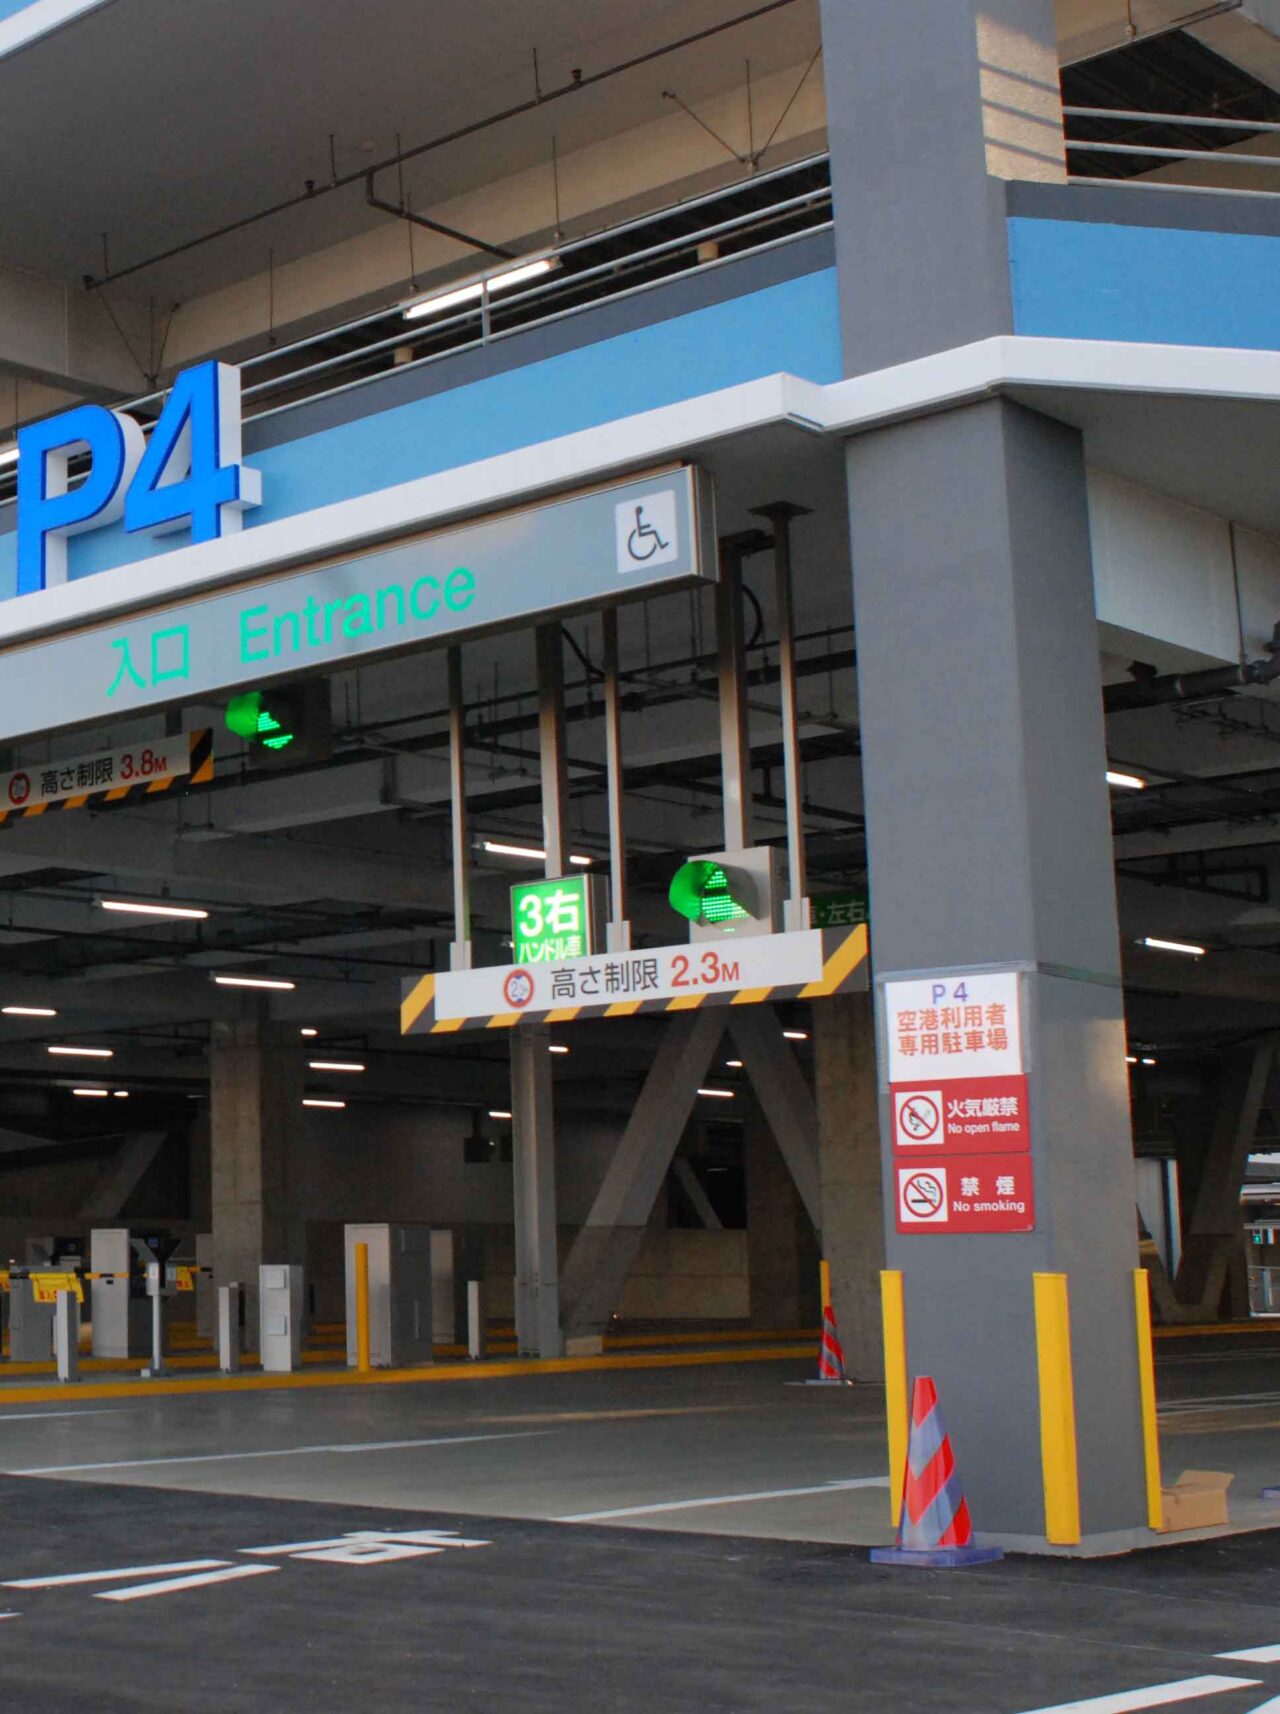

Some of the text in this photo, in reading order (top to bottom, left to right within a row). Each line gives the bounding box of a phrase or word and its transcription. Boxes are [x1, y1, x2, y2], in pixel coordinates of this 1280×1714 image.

[17, 360, 241, 597] P4
[107, 566, 476, 697] 入口 Entrance
[41, 757, 113, 797] 高さ制限
[519, 889, 580, 937] 3右
[519, 935, 582, 963] ハンドル車
[550, 958, 658, 1000] 高さ制限
[897, 1003, 1006, 1033] 空港利用者
[898, 1028, 1008, 1056] 専用駐車場
[947, 1097, 1019, 1118] 火気厳禁
[948, 1121, 1020, 1135] No open flame
[953, 1200, 1025, 1214] No smoking
